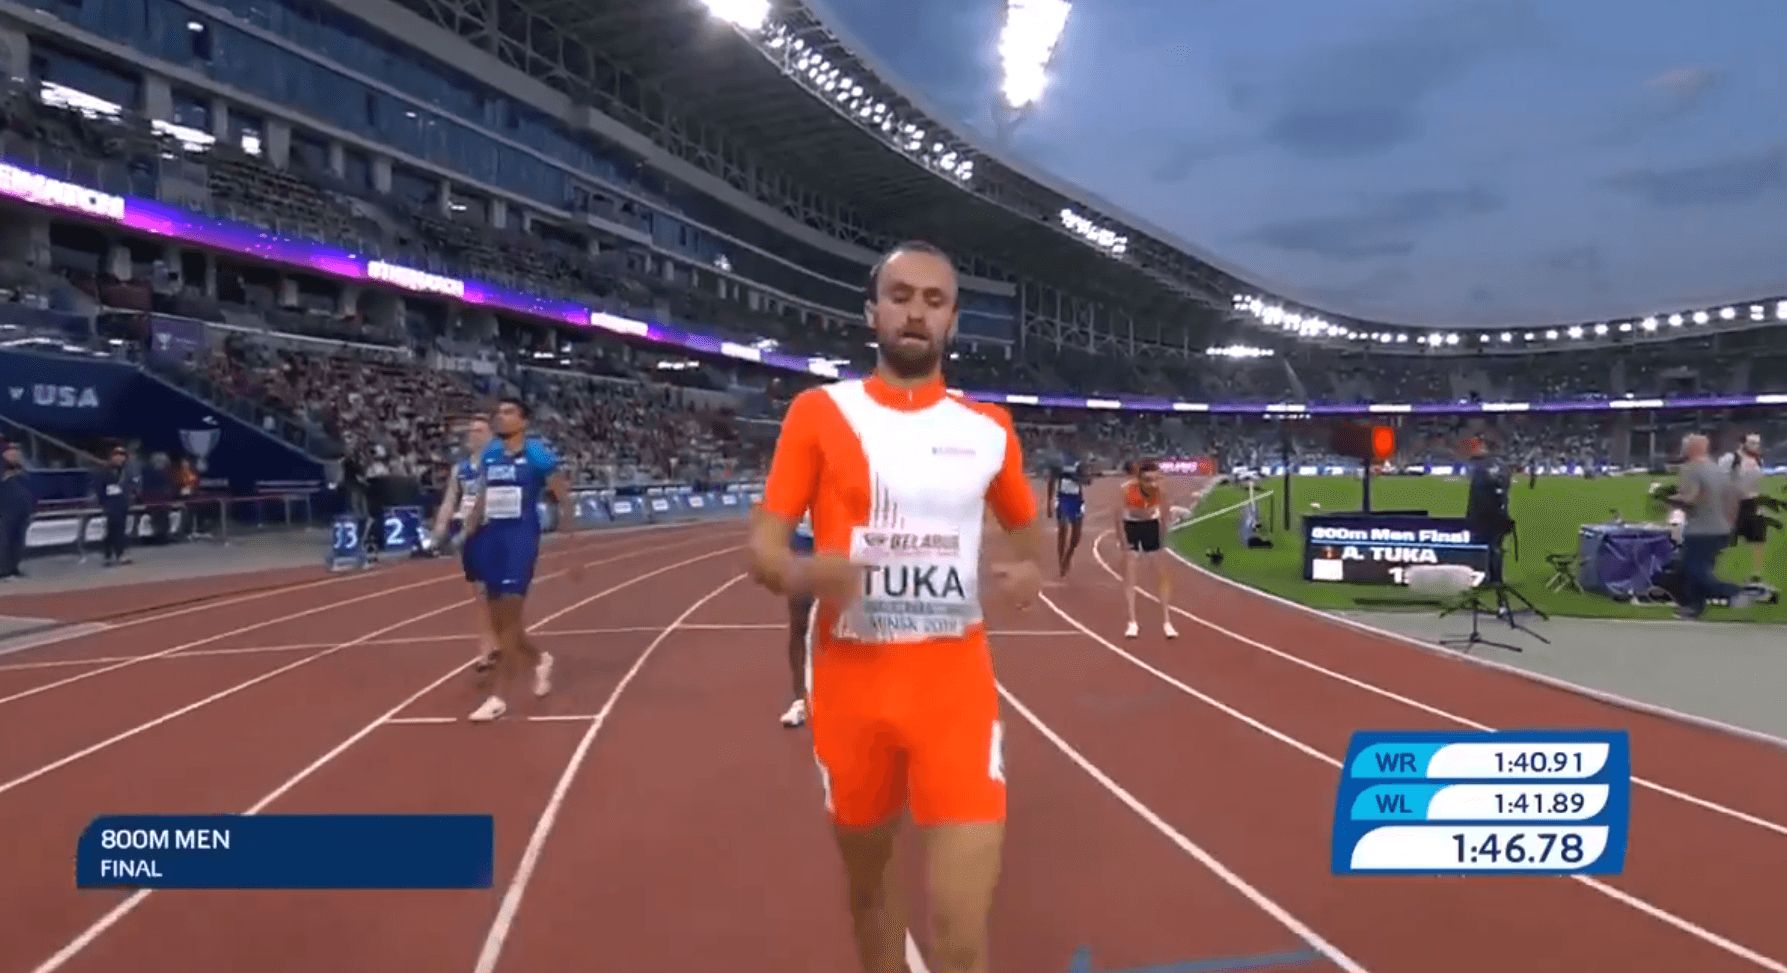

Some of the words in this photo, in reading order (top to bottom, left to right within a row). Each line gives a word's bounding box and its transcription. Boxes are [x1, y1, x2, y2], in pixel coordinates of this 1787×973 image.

[33, 383, 99, 408] USA
[384, 517, 405, 545] 2
[1311, 527, 1367, 541] 800m
[1370, 528, 1415, 542] Men
[1418, 529, 1470, 543] Final
[1341, 546, 1365, 560] A.
[1370, 547, 1438, 563] TUKA
[864, 565, 965, 599] TUKA
